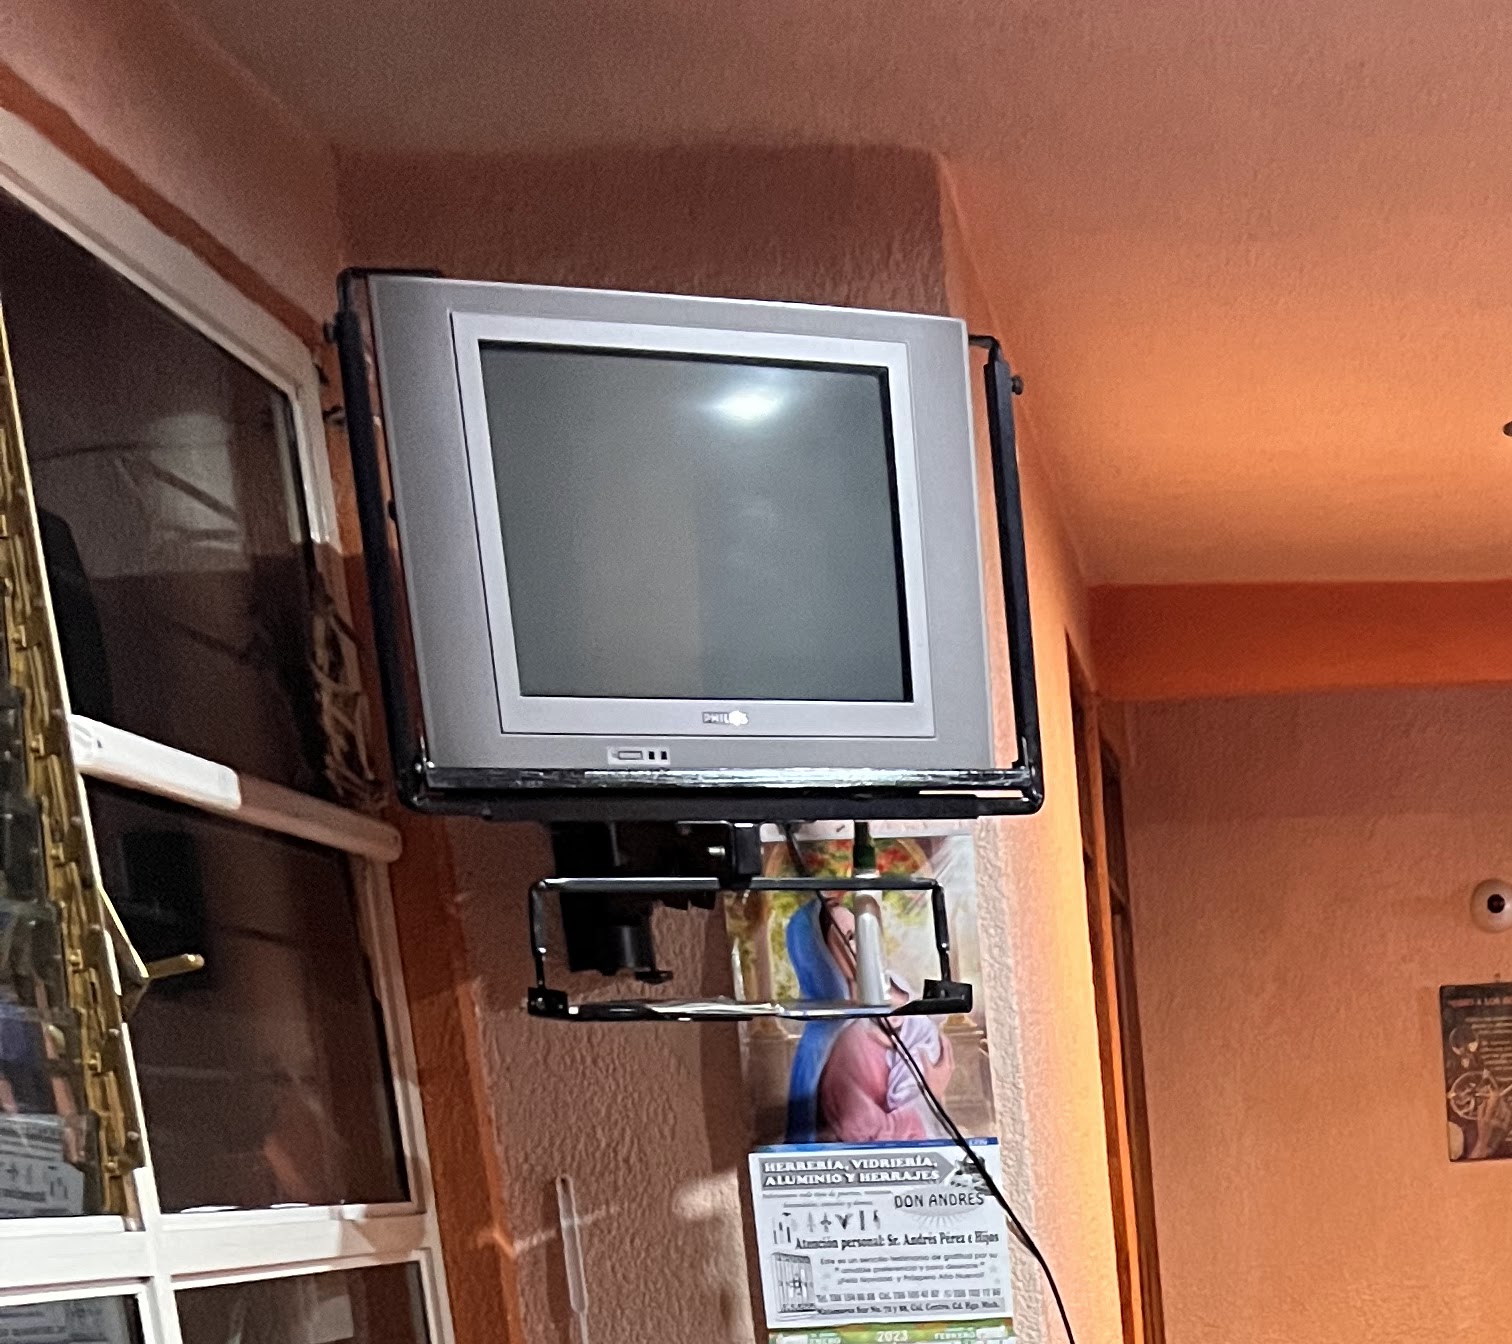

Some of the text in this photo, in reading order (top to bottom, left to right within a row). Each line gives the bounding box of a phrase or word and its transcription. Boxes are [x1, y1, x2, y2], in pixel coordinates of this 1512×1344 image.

[764, 1155, 938, 1173] HERRERÍA, VIDRIERÍA,
[764, 1169, 940, 1186] ALUMINIO Y HERRAJES
[894, 1192, 985, 1209] DON ANDRES
[876, 1329, 909, 1343] 2023
